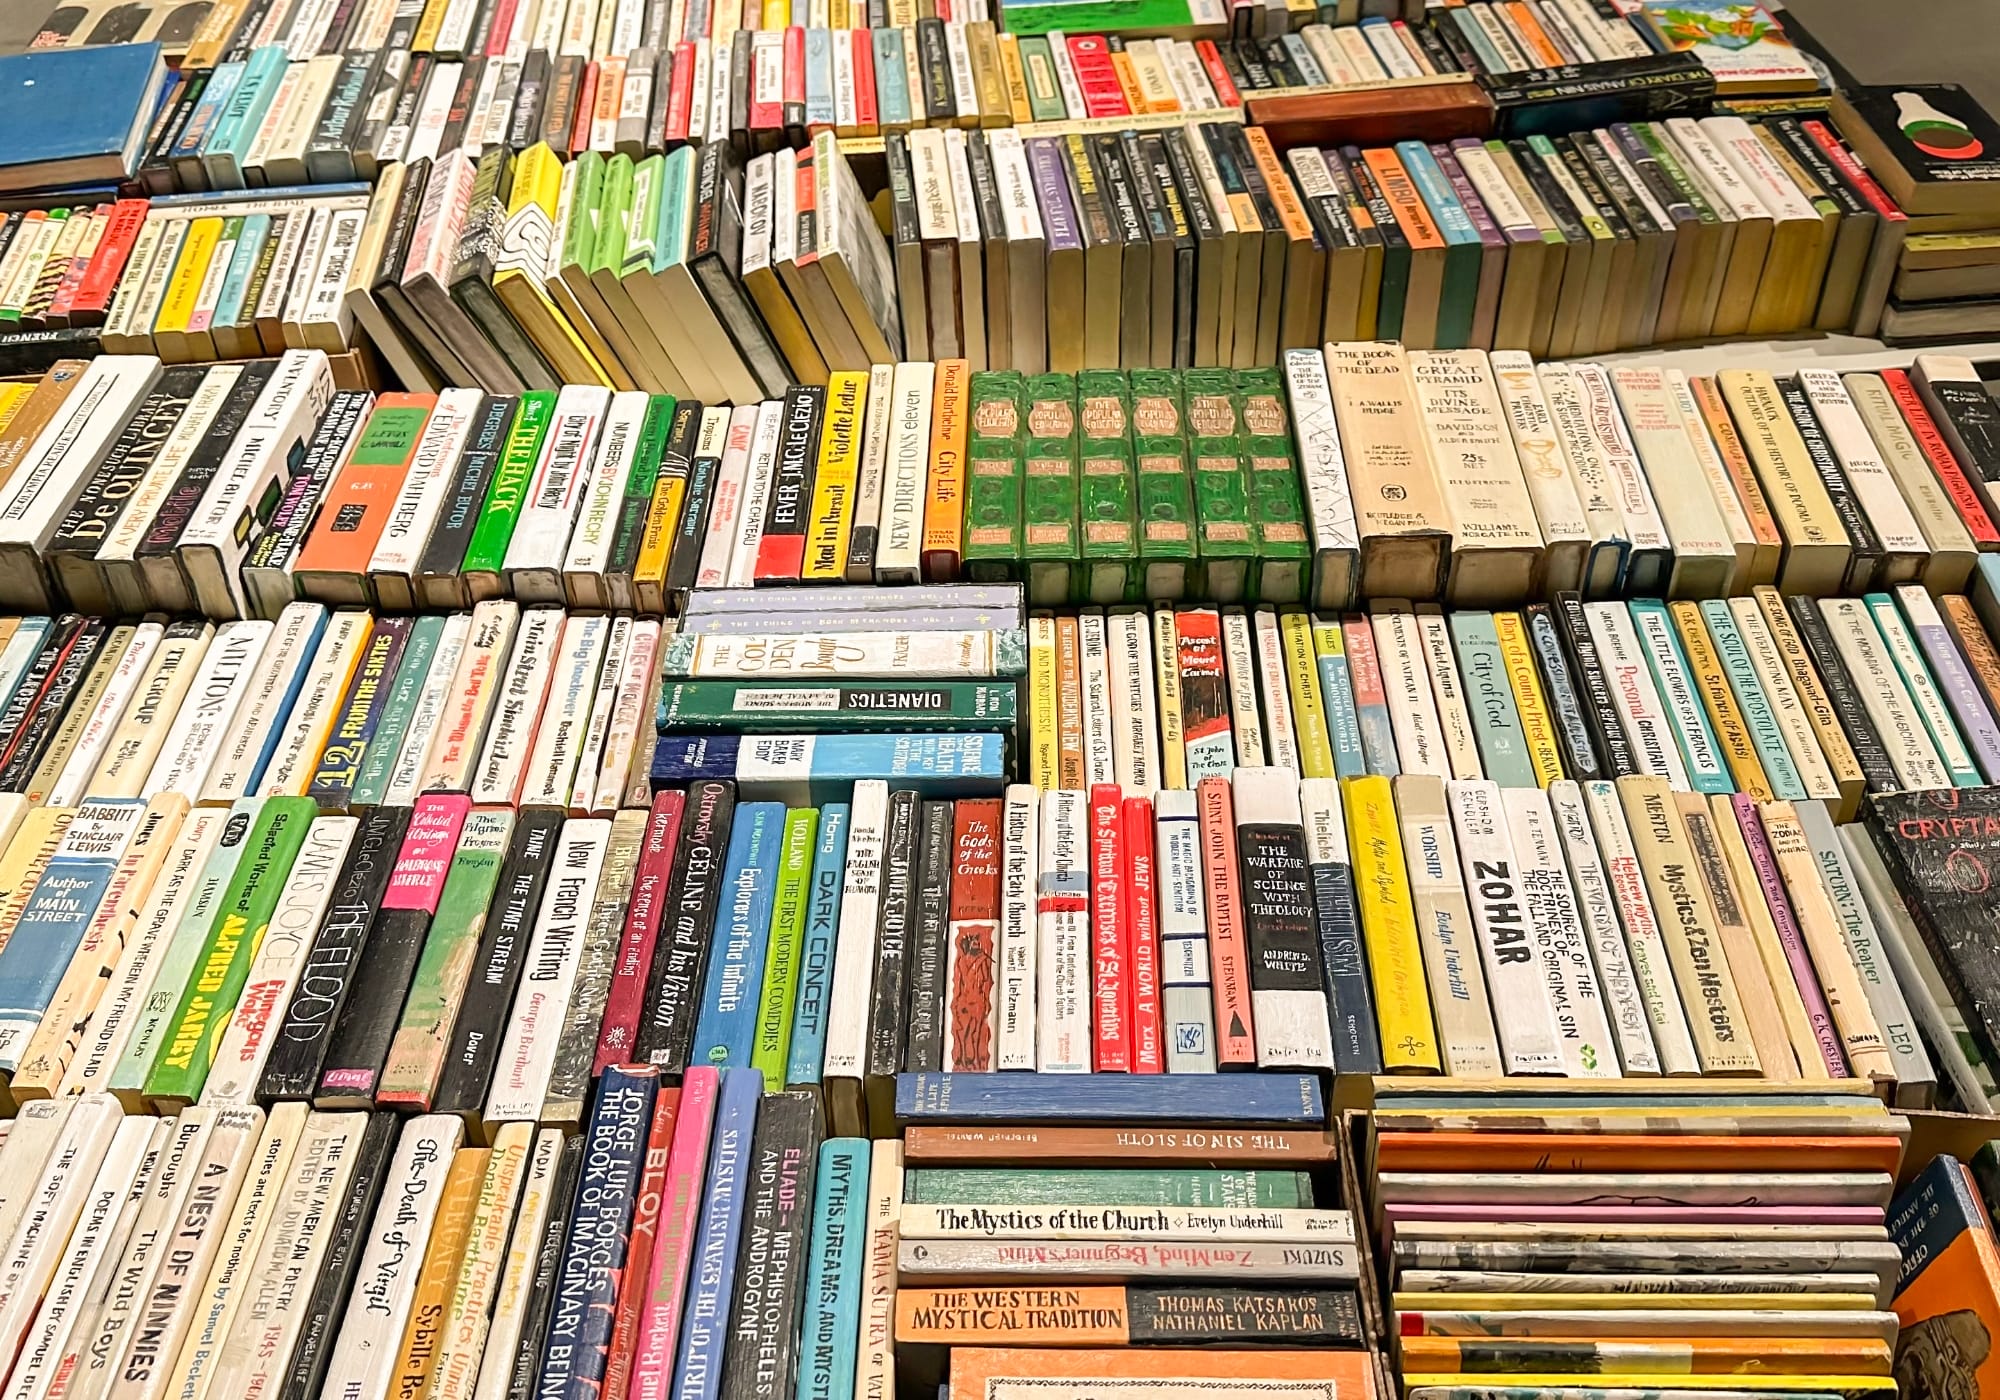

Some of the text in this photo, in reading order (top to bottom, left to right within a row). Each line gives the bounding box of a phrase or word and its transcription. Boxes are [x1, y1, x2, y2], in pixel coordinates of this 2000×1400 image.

[1380, 168, 1417, 208] LIMBO
[1336, 349, 1395, 359] THE BOOK
[1429, 357, 1460, 366] THE
[1338, 366, 1399, 374] THE DEAD
[1416, 376, 1483, 384] PYRAMID
[1417, 366, 1480, 376] GREAT
[1443, 390, 1468, 398] ITS
[564, 415, 587, 429] City
[827, 379, 858, 464] Violette Leduc
[902, 390, 920, 430] eleven
[476, 402, 507, 453] DEGREES
[702, 416, 720, 451] Tropisms
[101, 392, 191, 499] QUINCEY
[415, 414, 453, 473] EDWARD
[555, 439, 581, 459] Night
[606, 422, 630, 466] NUMBERS
[463, 456, 487, 493] MICHEL
[489, 424, 538, 513] THE HACK
[547, 470, 570, 487] John
[756, 452, 770, 481] RETURN
[936, 450, 957, 503] City Life
[775, 483, 799, 524] FEVER
[742, 507, 761, 546] CHATEAU
[816, 526, 838, 540] in
[814, 545, 836, 571] Mad
[1179, 636, 1217, 646] Ascent
[1181, 655, 1217, 664] Mount
[1181, 668, 1219, 677] Carmel
[1710, 612, 1784, 752] THE SOUL OF THE APOSTOLATE
[849, 694, 942, 708] DIANETICS
[756, 740, 772, 762] EDDY
[774, 740, 789, 765] BAKER
[77, 806, 137, 821] BABBITT
[1643, 794, 1674, 844] MERTON
[66, 831, 124, 841] SINCLAIR
[968, 821, 988, 833] The
[66, 842, 113, 852] LEWIS
[960, 837, 993, 848] Gods
[960, 849, 993, 860] of the
[1259, 846, 1289, 856] THE
[1419, 826, 1443, 879] WORSHIP
[1208, 793, 1233, 942] SAINT JOHN THE BAPTIST
[1246, 855, 1303, 868] WARFARE
[1268, 870, 1283, 878] OF
[42, 877, 93, 888] Author
[56, 887, 71, 898] of
[1253, 880, 1307, 891] SCIENCE
[35, 898, 80, 910] MAIN
[486, 828, 548, 985] TAINE THE TIME STREAM
[1252, 904, 1313, 916] THEOLOGY
[1262, 892, 1301, 903] WITH
[23, 912, 86, 922] STREET
[530, 841, 595, 980] New French Writing
[1472, 860, 1532, 967] ZOHAR
[800, 814, 842, 1035] Honig DARK CONCEIT
[1550, 869, 1595, 999] THE SOURCES OF THE
[286, 900, 371, 1042] THE FLOOD
[1136, 855, 1157, 1065] Marx A WORLD without JEWS
[1264, 960, 1307, 971] WHITE
[462, 1032, 483, 1065] Dover
[1887, 1023, 1914, 1055] LEO
[1116, 1131, 1290, 1150] SLOTH OF SIN THE
[158, 1124, 200, 1200] Burroughs
[534, 1139, 553, 1180] NADJA
[584, 1088, 645, 1292] JORGE LUIS BORGES
[634, 1147, 668, 1237] BLOY
[552, 1088, 622, 1338] THE BOOK OF IMAGINARY
[937, 1208, 1283, 1234] The Mystics of the Church Evelyn Underhill
[736, 1150, 778, 1341] AND THE ANDROGYNE
[1282, 1249, 1344, 1266] SUZUKI
[126, 1162, 229, 1382] A NEST OF NINNIES
[932, 1290, 1080, 1308] THE WESTERN
[912, 1310, 1123, 1330] MYSTICAL TRADITION
[1153, 1314, 1325, 1330] NATHANIEL KAPLAN
[407, 1304, 442, 1370] Sybille
